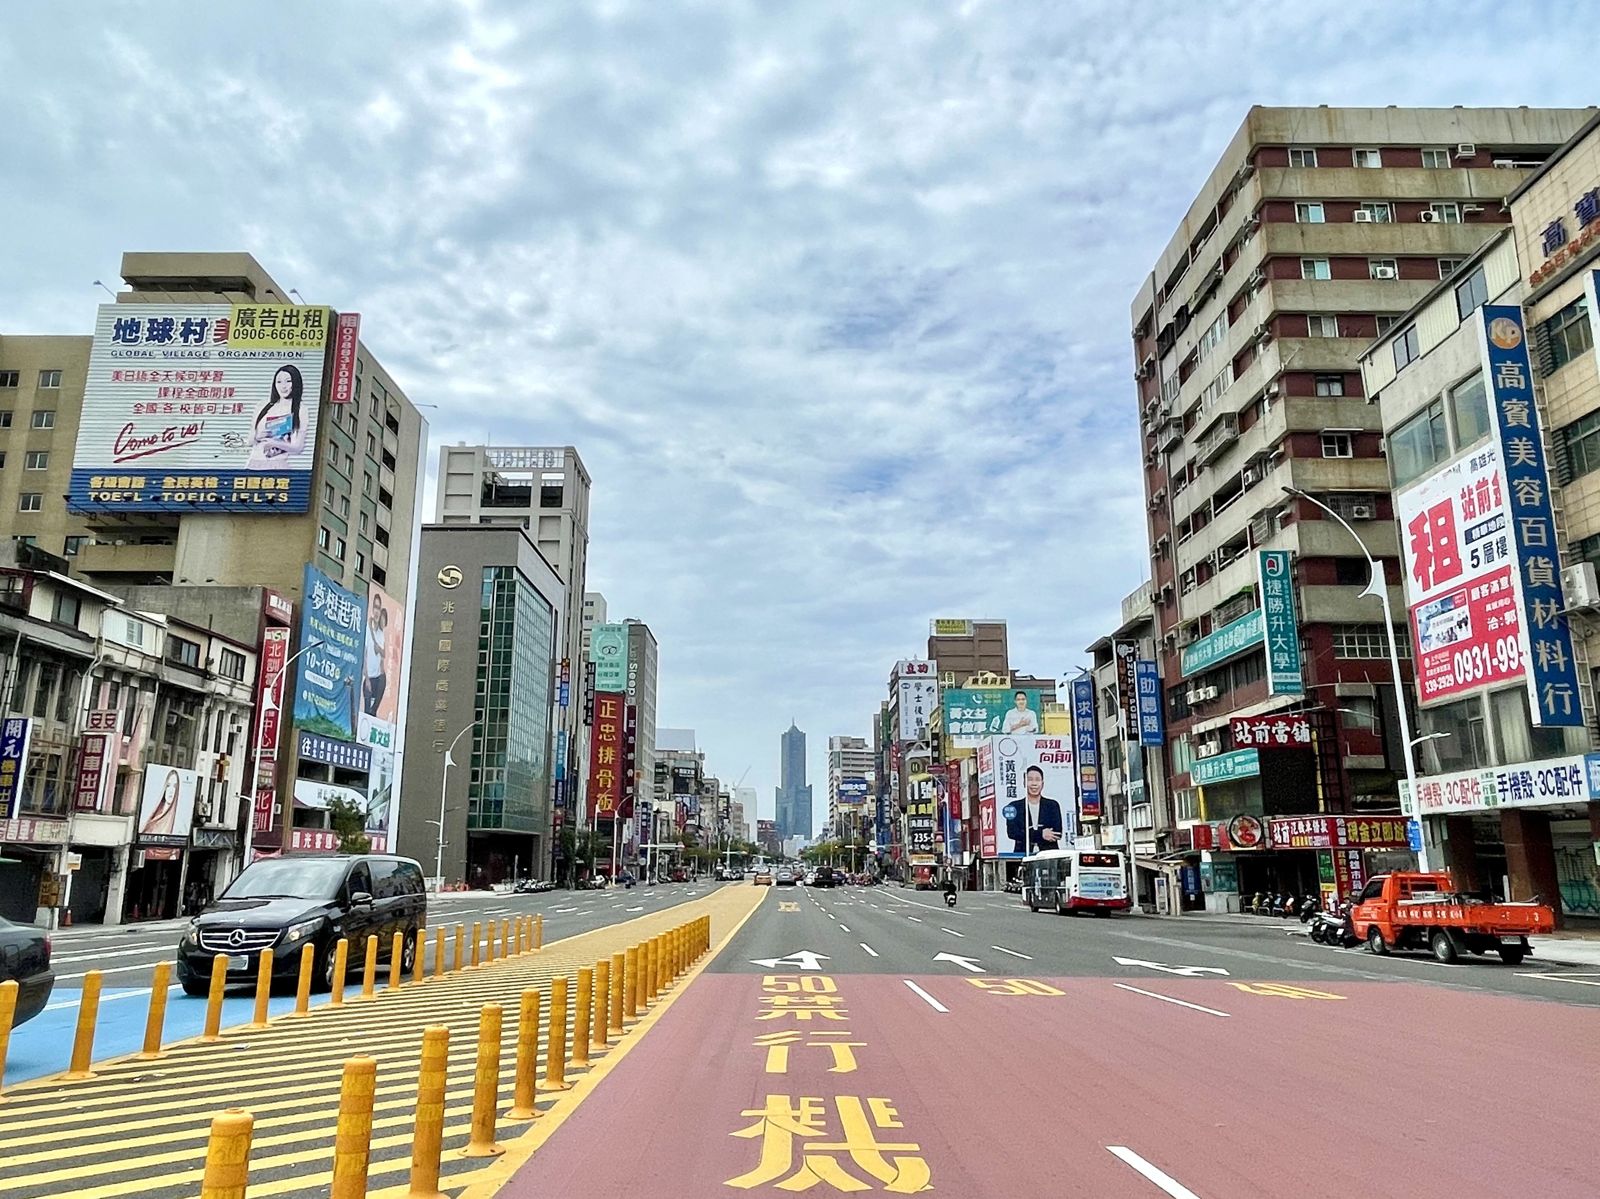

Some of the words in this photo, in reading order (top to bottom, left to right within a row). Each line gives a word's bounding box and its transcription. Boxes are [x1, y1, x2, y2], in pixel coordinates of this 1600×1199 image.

[233, 329, 324, 340] 0906-666-603
[234, 308, 323, 328] 廣告出租
[111, 350, 155, 358] GLOBAL
[162, 350, 210, 358] VILLAGE
[217, 350, 303, 358] ORGANIZATION
[162, 492, 217, 502] TOEIC
[1409, 497, 1464, 592] 租
[1495, 360, 1573, 715] 高賓美容百貨材料行
[312, 580, 361, 633] 夢想起飛
[1266, 579, 1291, 669] 捷勝升大學
[628, 663, 638, 695] Sleep
[1126, 647, 1136, 684] PUNCH
[1129, 699, 1139, 734] POWER
[1140, 677, 1159, 733] 助聽器
[1035, 739, 1062, 749] 高雄
[1077, 700, 1095, 765] 求精外語
[596, 699, 617, 812] 正忠排骨飯
[1040, 750, 1072, 763] 向前
[1005, 760, 1017, 798] 黃紹庭
[762, 975, 838, 993] 50
[965, 978, 1067, 996] 50
[722, 994, 936, 1194] 禁行機
